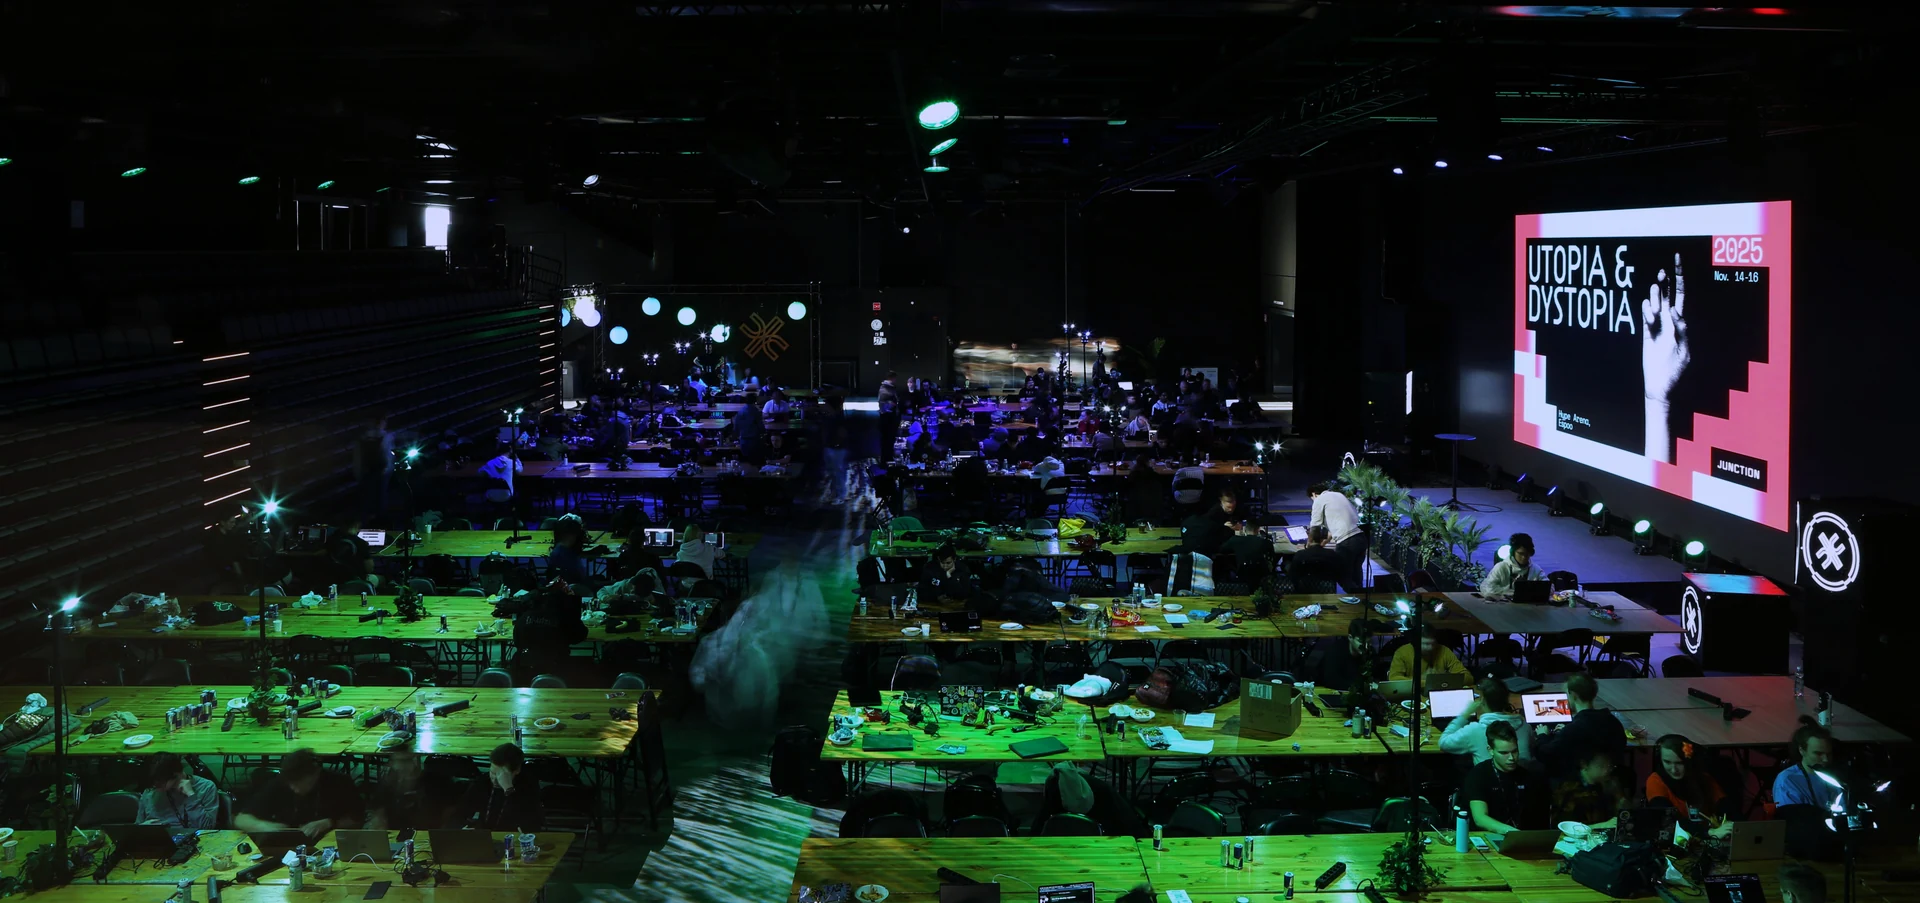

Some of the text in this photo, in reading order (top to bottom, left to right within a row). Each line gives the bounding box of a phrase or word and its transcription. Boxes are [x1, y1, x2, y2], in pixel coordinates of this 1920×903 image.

[1714, 237, 1763, 264] 2025
[1528, 245, 1635, 288] UTOPIA &
[1714, 270, 1759, 283] Nov. 14-16
[1528, 284, 1635, 335] DYSTOPIA
[1558, 409, 1591, 428] Hype Arena,
[1558, 419, 1574, 430] Espoo
[1716, 459, 1761, 480] JUNCTION
